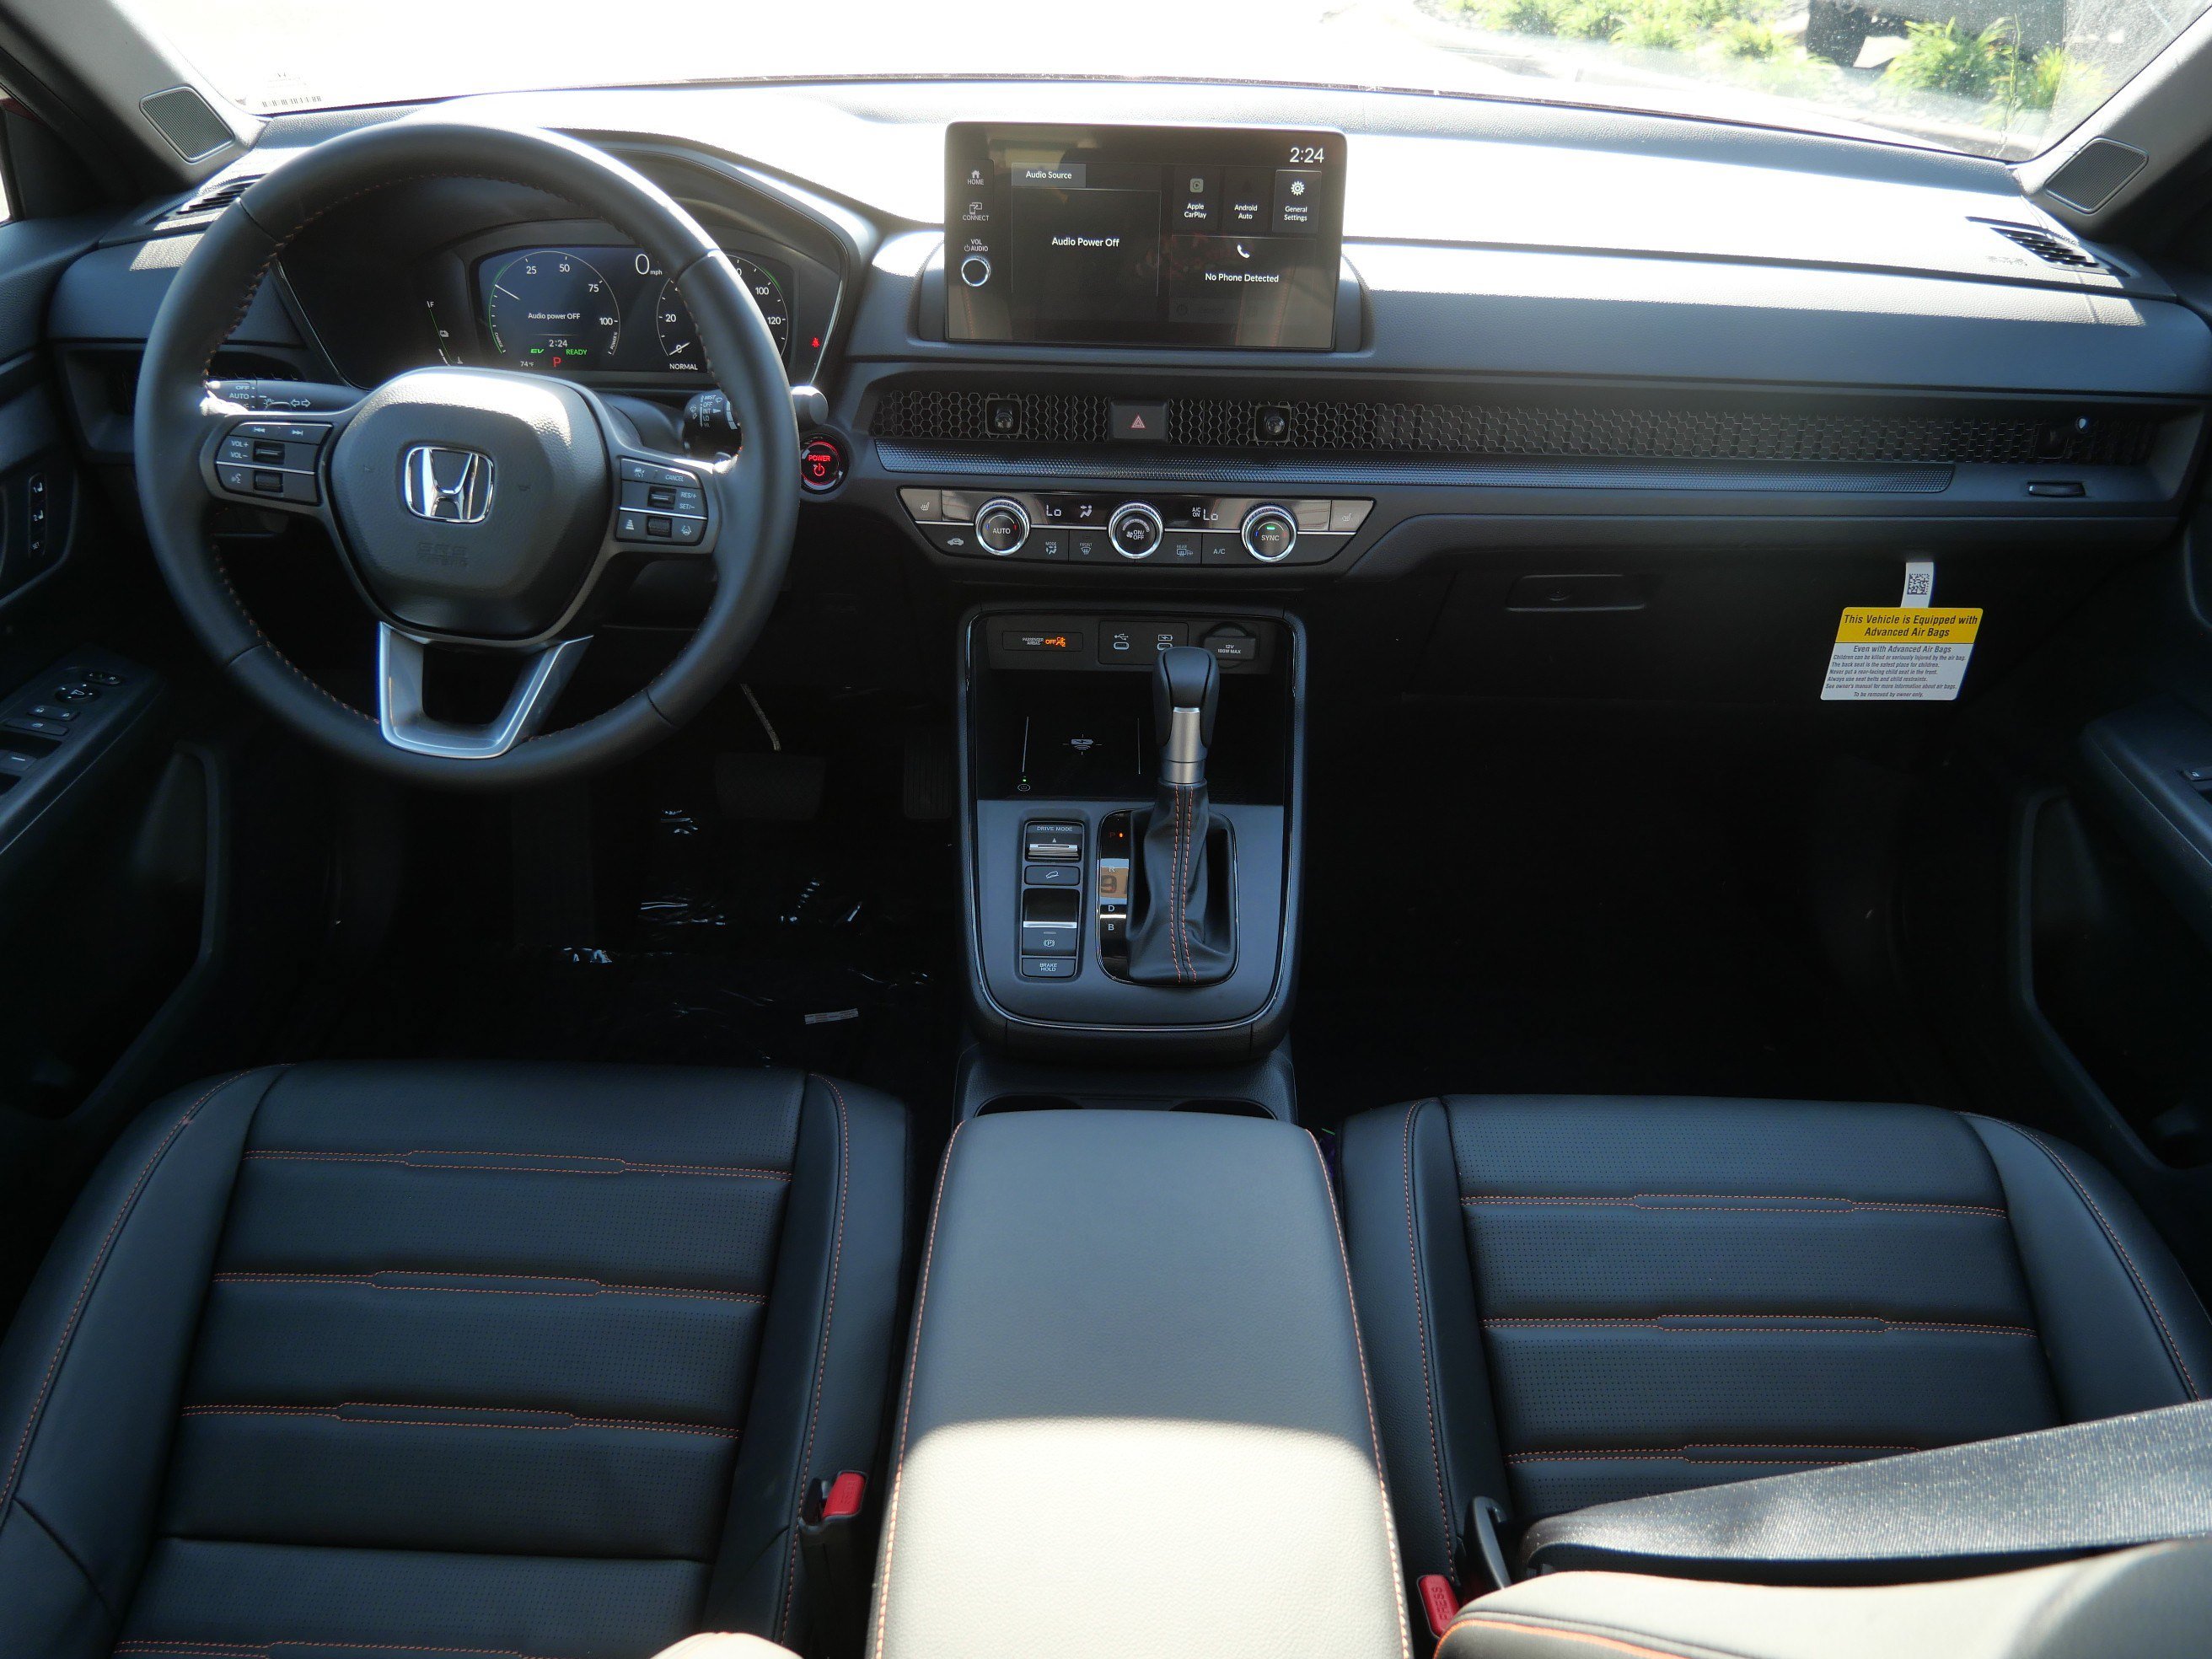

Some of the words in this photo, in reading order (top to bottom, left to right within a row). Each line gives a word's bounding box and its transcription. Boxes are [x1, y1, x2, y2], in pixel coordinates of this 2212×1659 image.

[1290, 148, 1324, 164] 2:24
[1048, 171, 1071, 180] Source
[1052, 237, 1076, 246] Audio
[1077, 238, 1103, 247] Power
[1105, 239, 1119, 247] Off
[559, 264, 570, 272] 50
[636, 254, 649, 275] 0
[526, 266, 537, 275] 25
[588, 284, 599, 293] 75
[755, 287, 769, 295] 100
[528, 312, 545, 320] Audio
[665, 314, 676, 323] 20
[599, 317, 613, 325] 100
[767, 317, 781, 325] 120
[553, 357, 561, 367] P
[665, 474, 684, 482] CANCEL
[1046, 505, 1061, 517] Lo
[1203, 508, 1218, 521] Lo
[1844, 615, 1863, 624] This
[1866, 615, 1900, 624] Vehicle
[1903, 615, 1910, 624] is
[1914, 615, 1956, 625] Equipped
[1958, 615, 1978, 625] with
[1864, 627, 1909, 636] Advanced
[1910, 628, 1925, 636] Air
[1927, 628, 1950, 638] Bags
